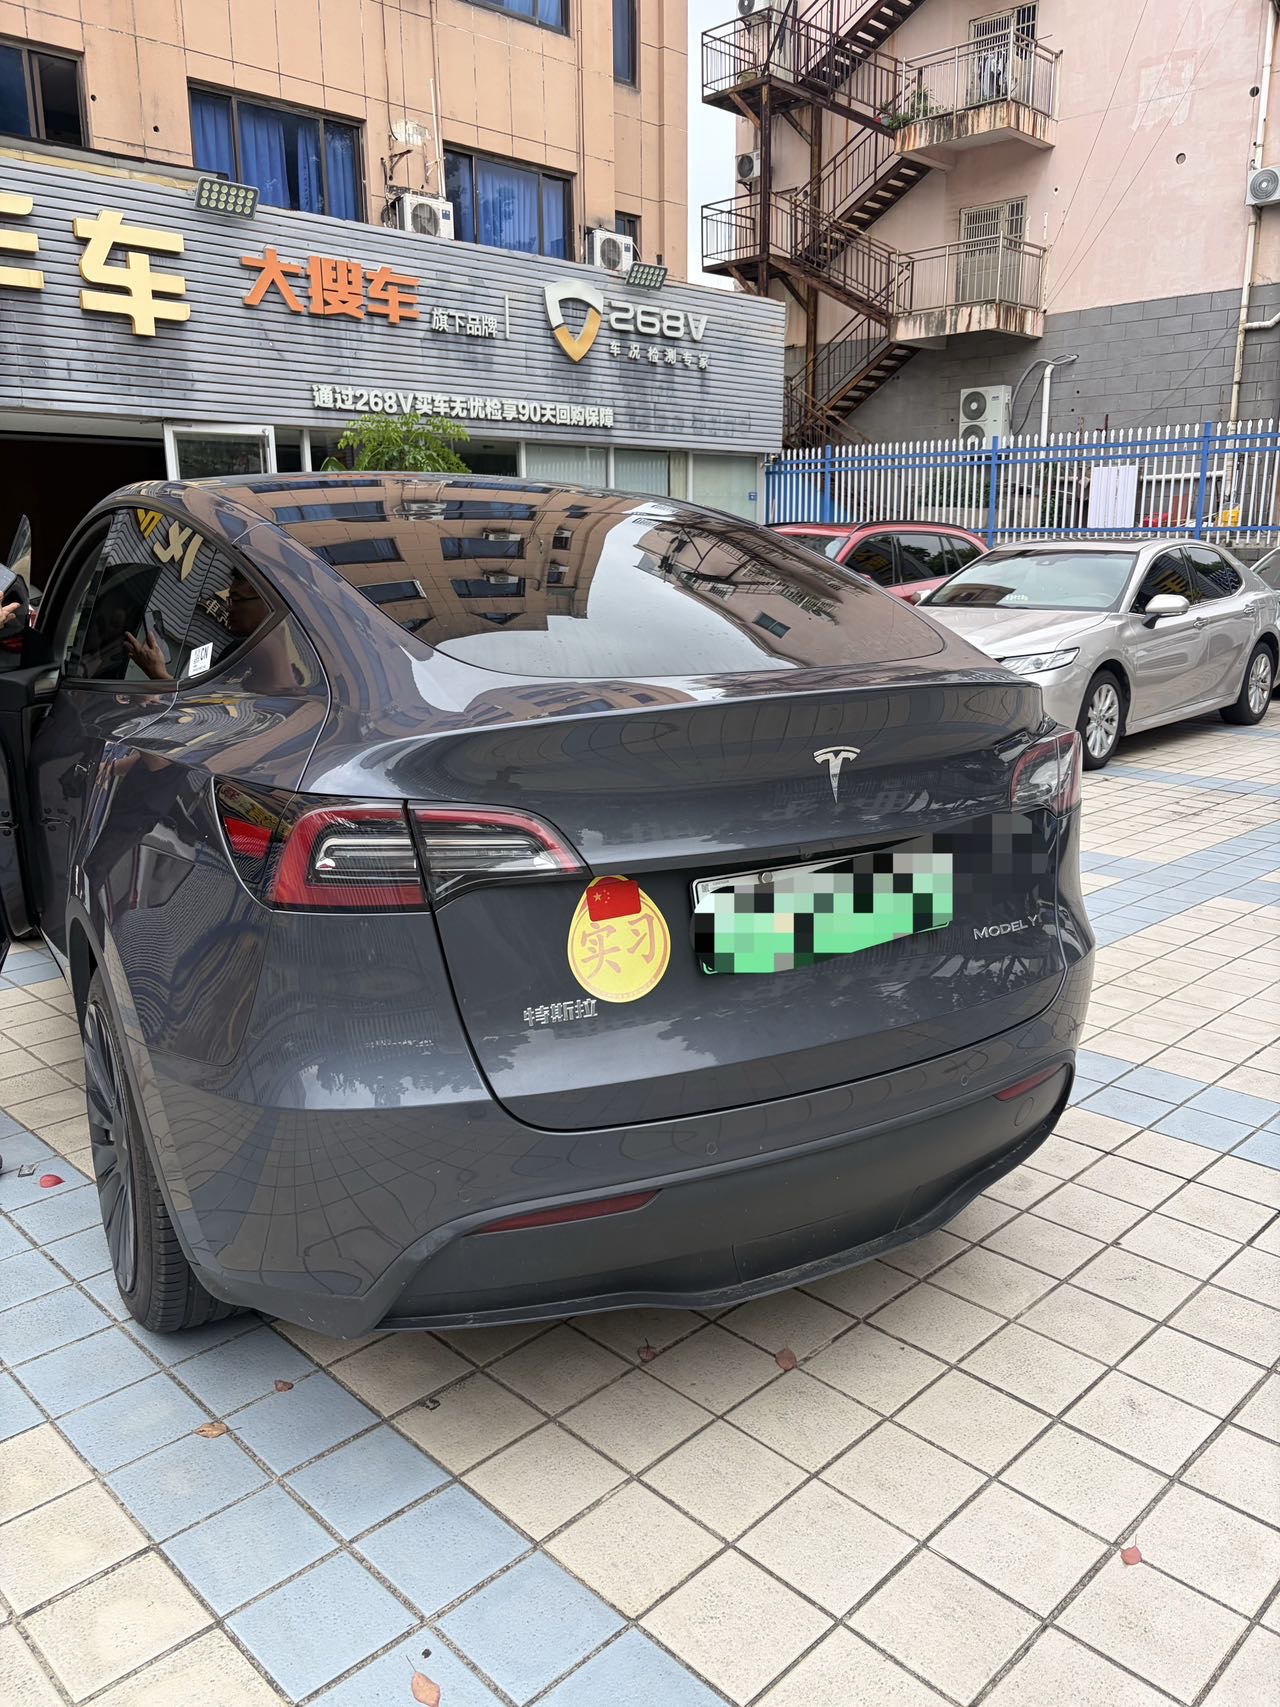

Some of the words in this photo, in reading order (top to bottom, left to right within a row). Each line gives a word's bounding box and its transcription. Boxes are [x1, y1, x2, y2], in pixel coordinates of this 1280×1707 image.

[240, 246, 420, 325] 大搜车
[431, 308, 498, 338] 旗下品牌
[608, 300, 709, 341] 268V
[609, 341, 709, 369] 车况检测专家
[311, 384, 614, 428] 通过268V买车无忧检享90天回购保障
[973, 920, 1029, 940] MODEL
[1027, 914, 1039, 927] Y
[580, 912, 656, 980] 实习
[523, 997, 598, 1027] 特斯拉
